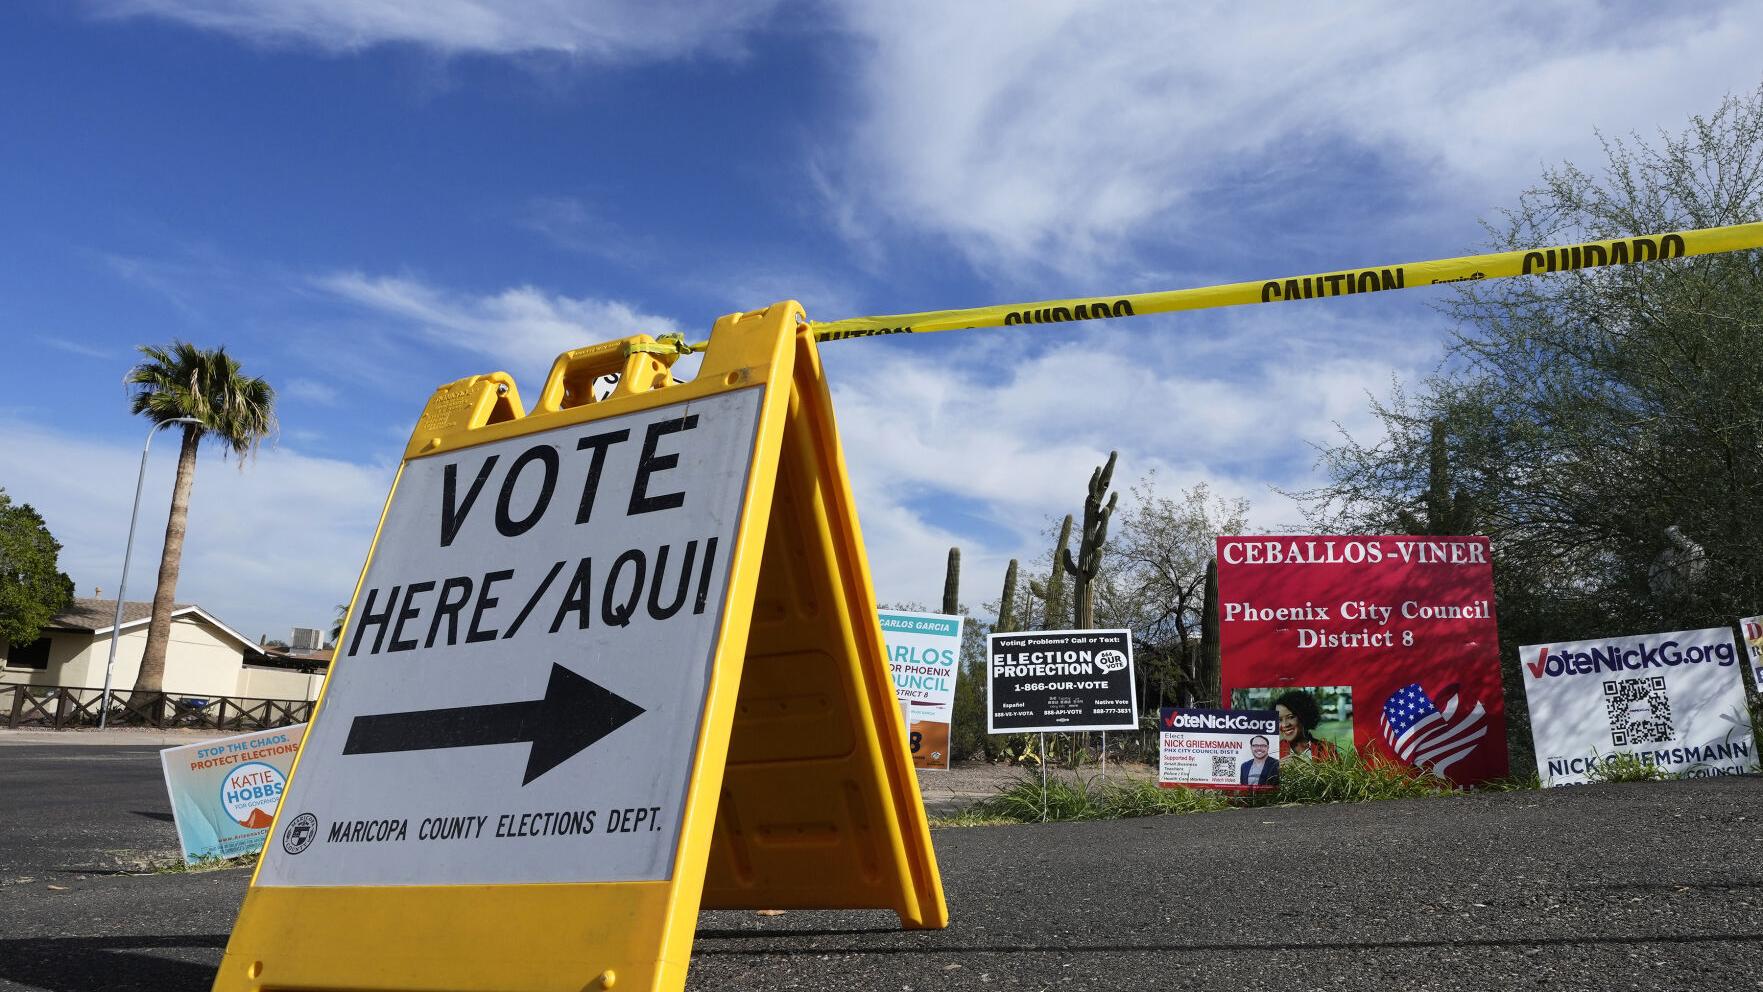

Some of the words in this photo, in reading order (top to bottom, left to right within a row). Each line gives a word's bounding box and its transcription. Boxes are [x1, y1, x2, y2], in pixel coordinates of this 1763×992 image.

[440, 414, 700, 548] VOTE
[347, 536, 719, 657] HERE/AQUI
[1224, 602, 1330, 621] Phoenix
[1340, 601, 1392, 625] City
[1401, 600, 1490, 619] Council
[880, 619, 914, 628] CARLOS
[916, 622, 950, 632] GARCIA
[1000, 639, 1026, 647] Voting
[1297, 628, 1393, 648] District
[1402, 630, 1414, 646] 8
[993, 651, 1092, 665] ELECTION
[1100, 656, 1121, 664] OUR
[890, 664, 902, 672] OR
[904, 666, 951, 676] PHOENIX
[993, 662, 1092, 678] PROTECTION
[1014, 681, 1109, 692] 1-866-OUR-VOTE
[197, 746, 225, 758] STOP
[227, 742, 248, 752] THE
[250, 734, 290, 748] CHAOS.
[1164, 740, 1184, 748] NICK
[1186, 740, 1242, 750] GRIEMSMANN
[190, 755, 239, 771] PROTECT
[241, 744, 298, 761] ELECTIONS
[1548, 756, 1597, 776] NICK
[1605, 742, 1749, 768] IEMSMANN
[231, 770, 274, 790] KATIE
[227, 782, 282, 804] HOBBS
[327, 818, 408, 844] MARICOPA
[418, 816, 488, 840] COUNTY
[496, 810, 597, 838] ELECTIONS
[607, 807, 662, 834] DEPT.
